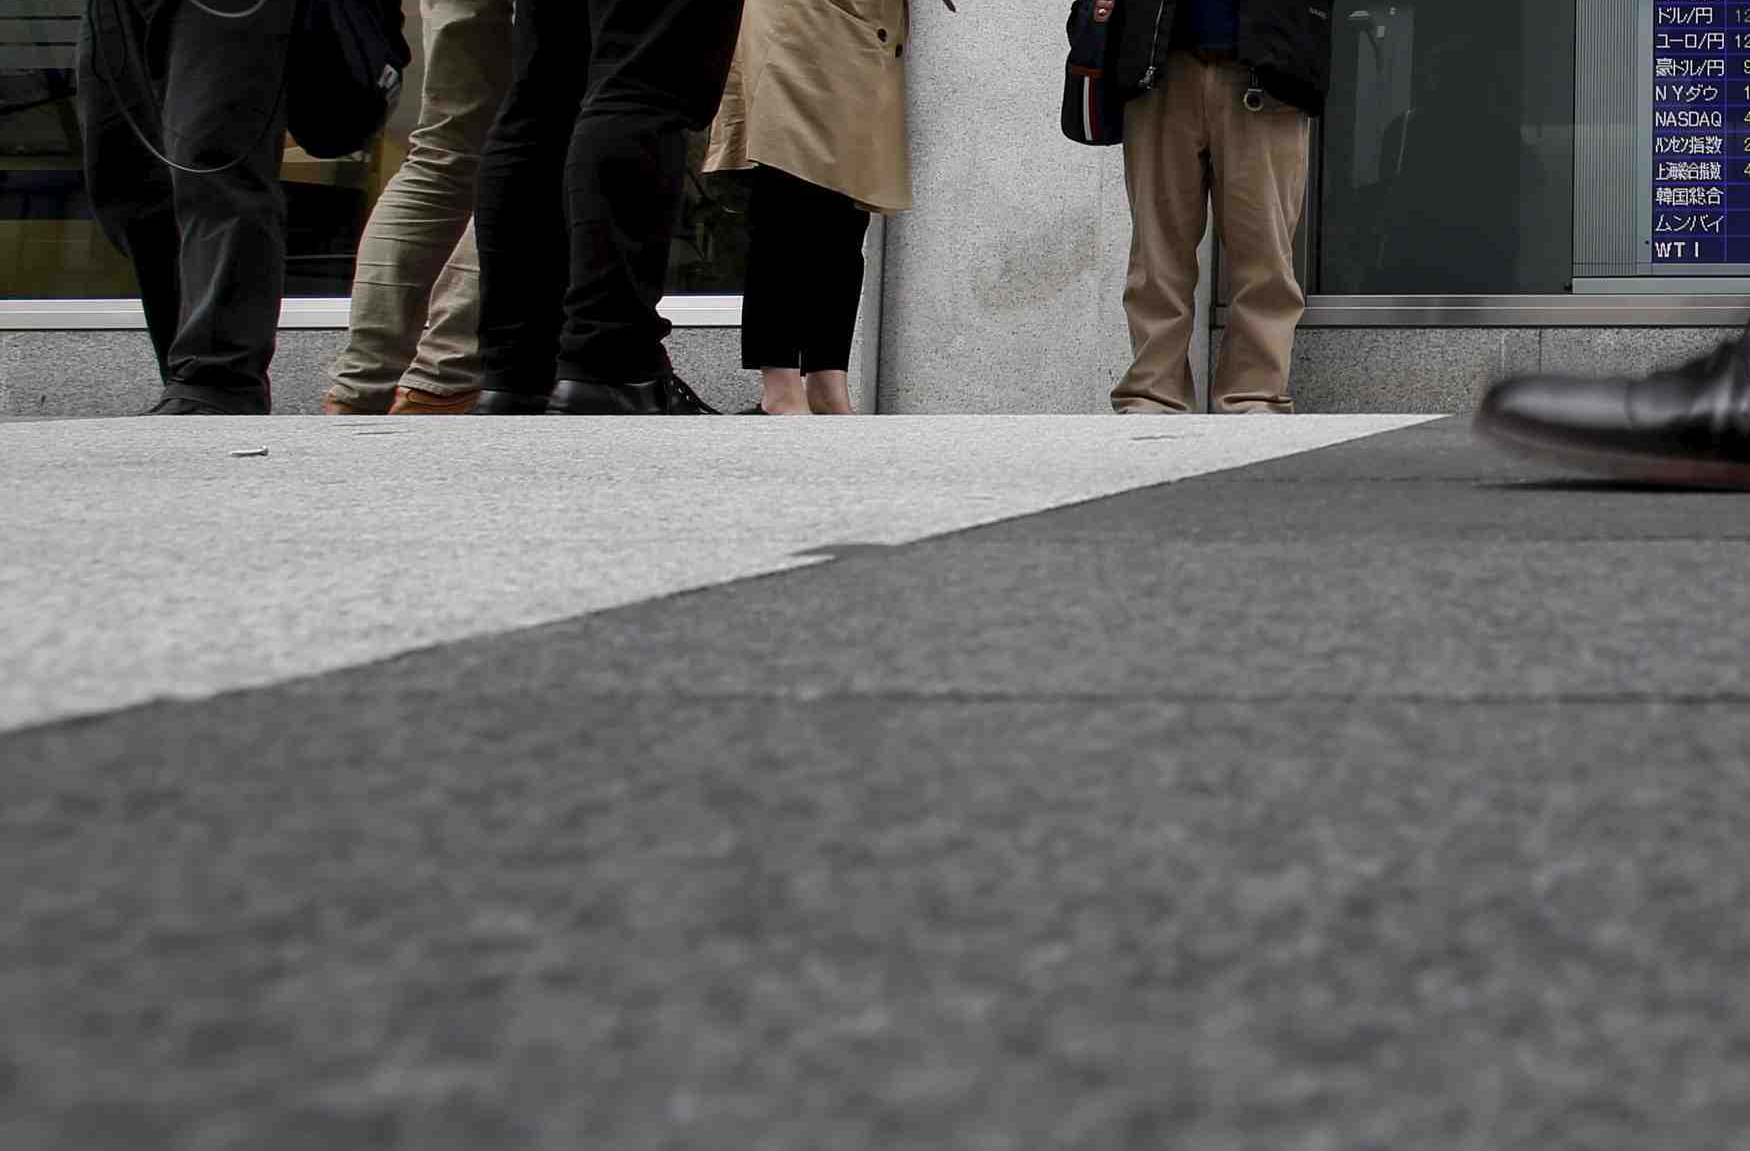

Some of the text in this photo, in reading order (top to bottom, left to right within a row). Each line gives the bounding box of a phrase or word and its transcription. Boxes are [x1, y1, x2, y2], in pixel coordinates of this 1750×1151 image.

[1658, 7, 1712, 25] ドル/円
[1656, 33, 1724, 50] ユーロ/円
[1656, 58, 1725, 77] 豪ドル/円
[1656, 112, 1722, 127] NASDAQ
[1656, 188, 1723, 206] 韓国総合
[1656, 215, 1723, 233] ムンバイ
